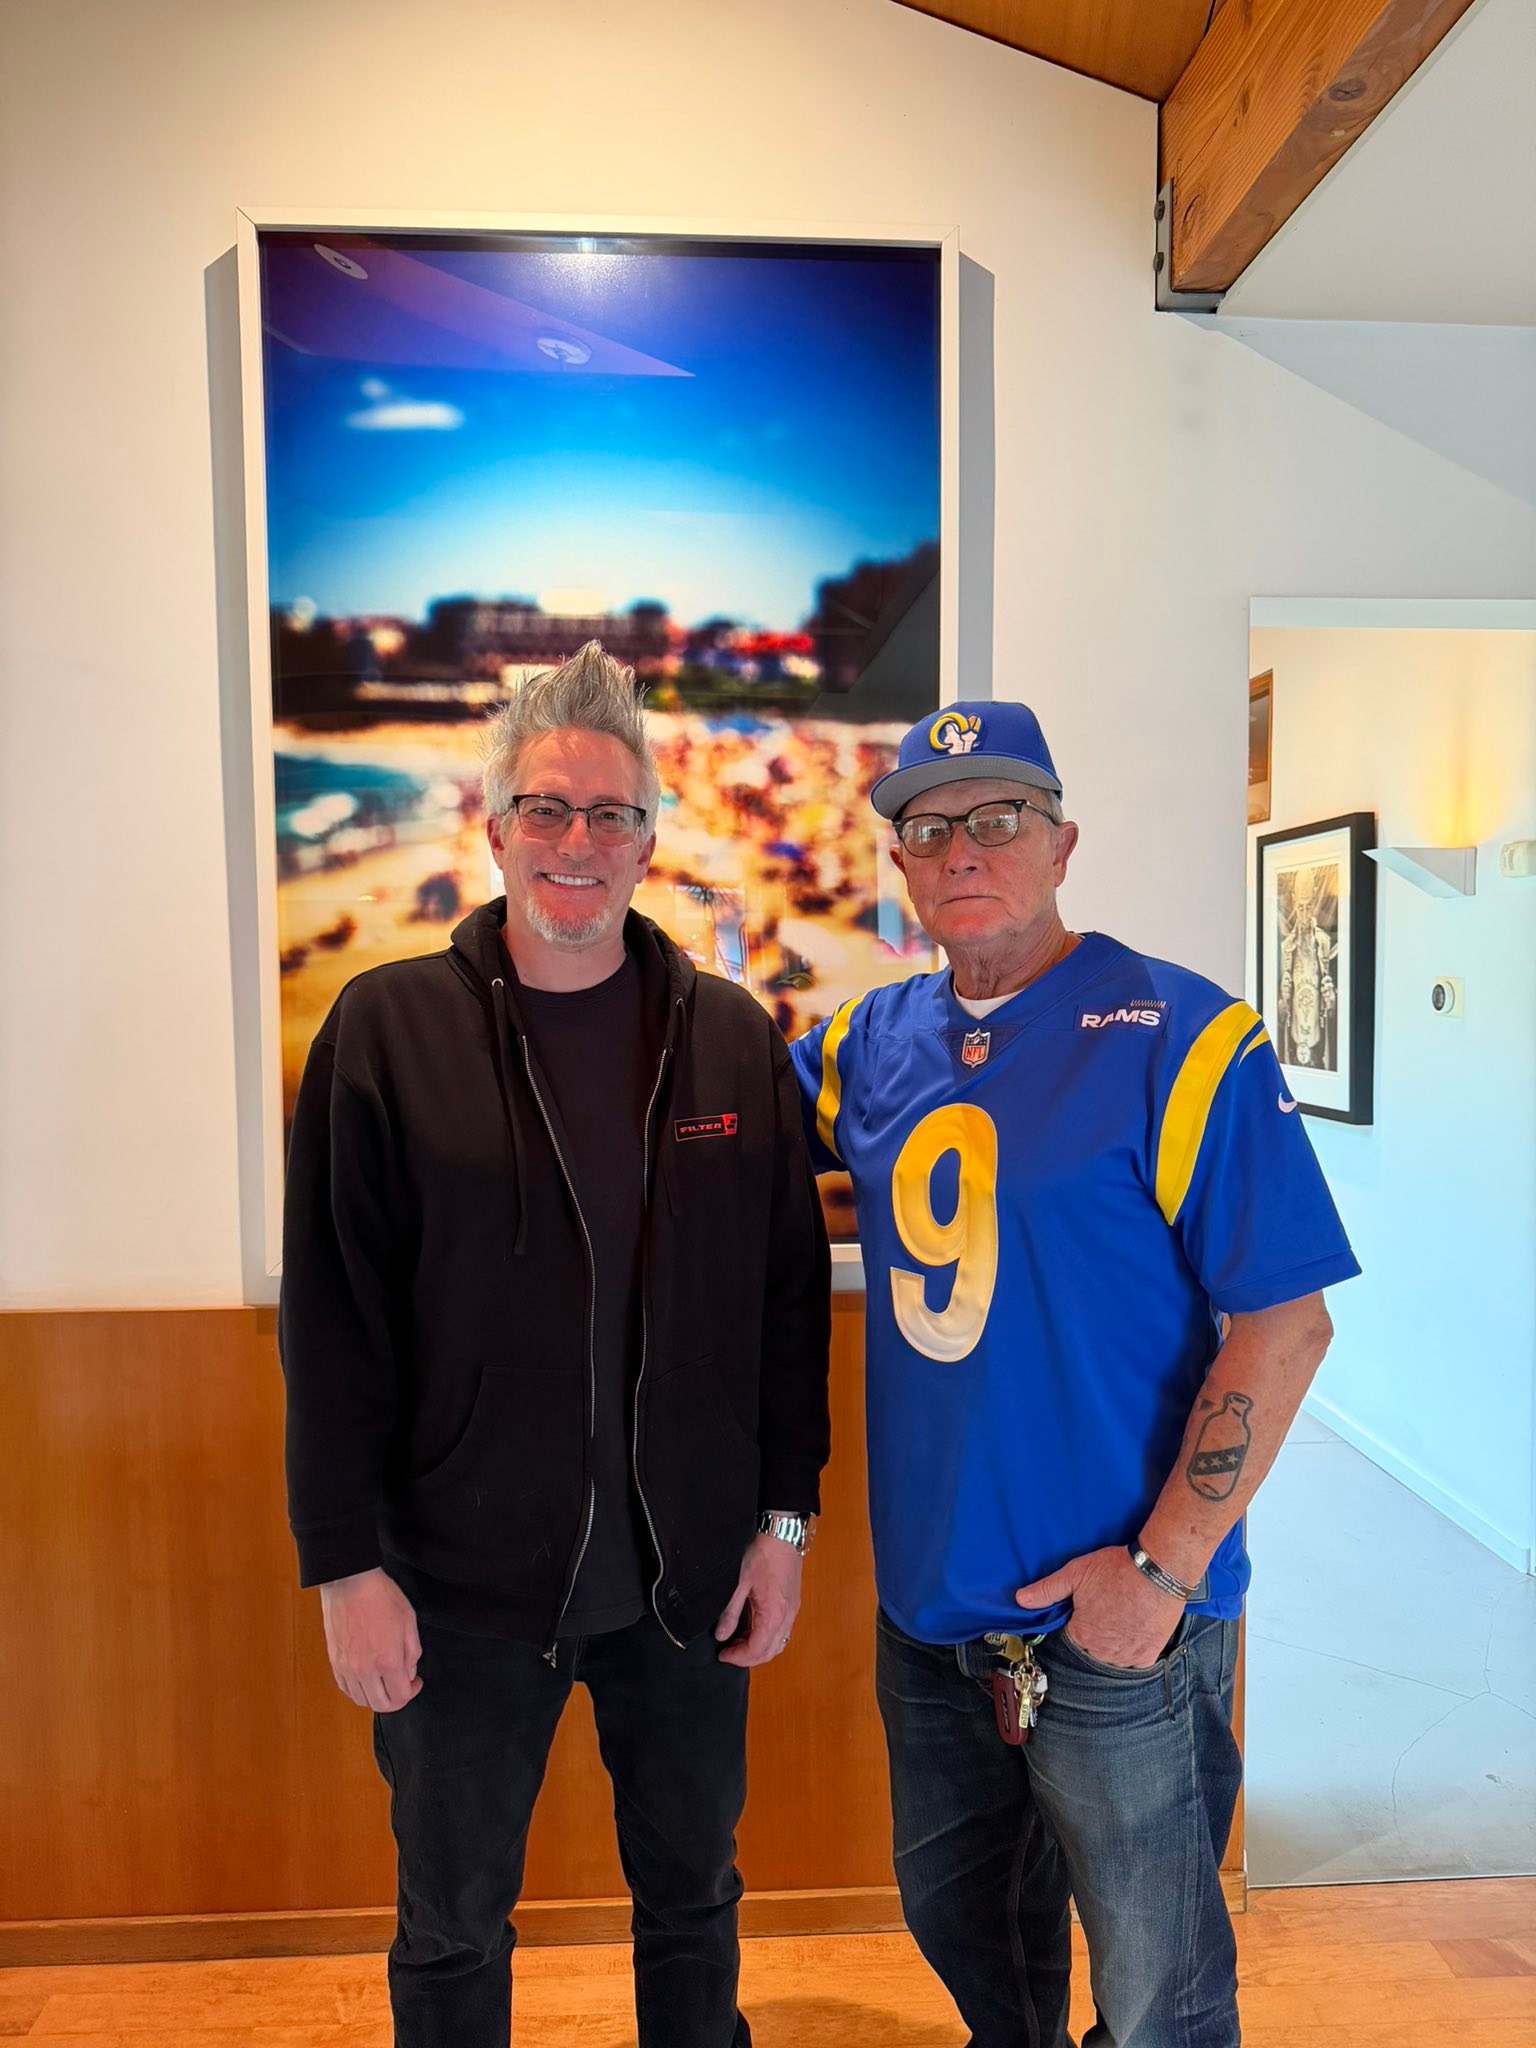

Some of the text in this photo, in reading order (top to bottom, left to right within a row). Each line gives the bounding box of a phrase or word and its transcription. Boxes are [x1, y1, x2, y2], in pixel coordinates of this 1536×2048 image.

[1080, 1008, 1161, 1028] RAMS
[966, 1046, 984, 1059] NFL
[680, 1123, 722, 1134] FILTER
[889, 1103, 999, 1363] 9
